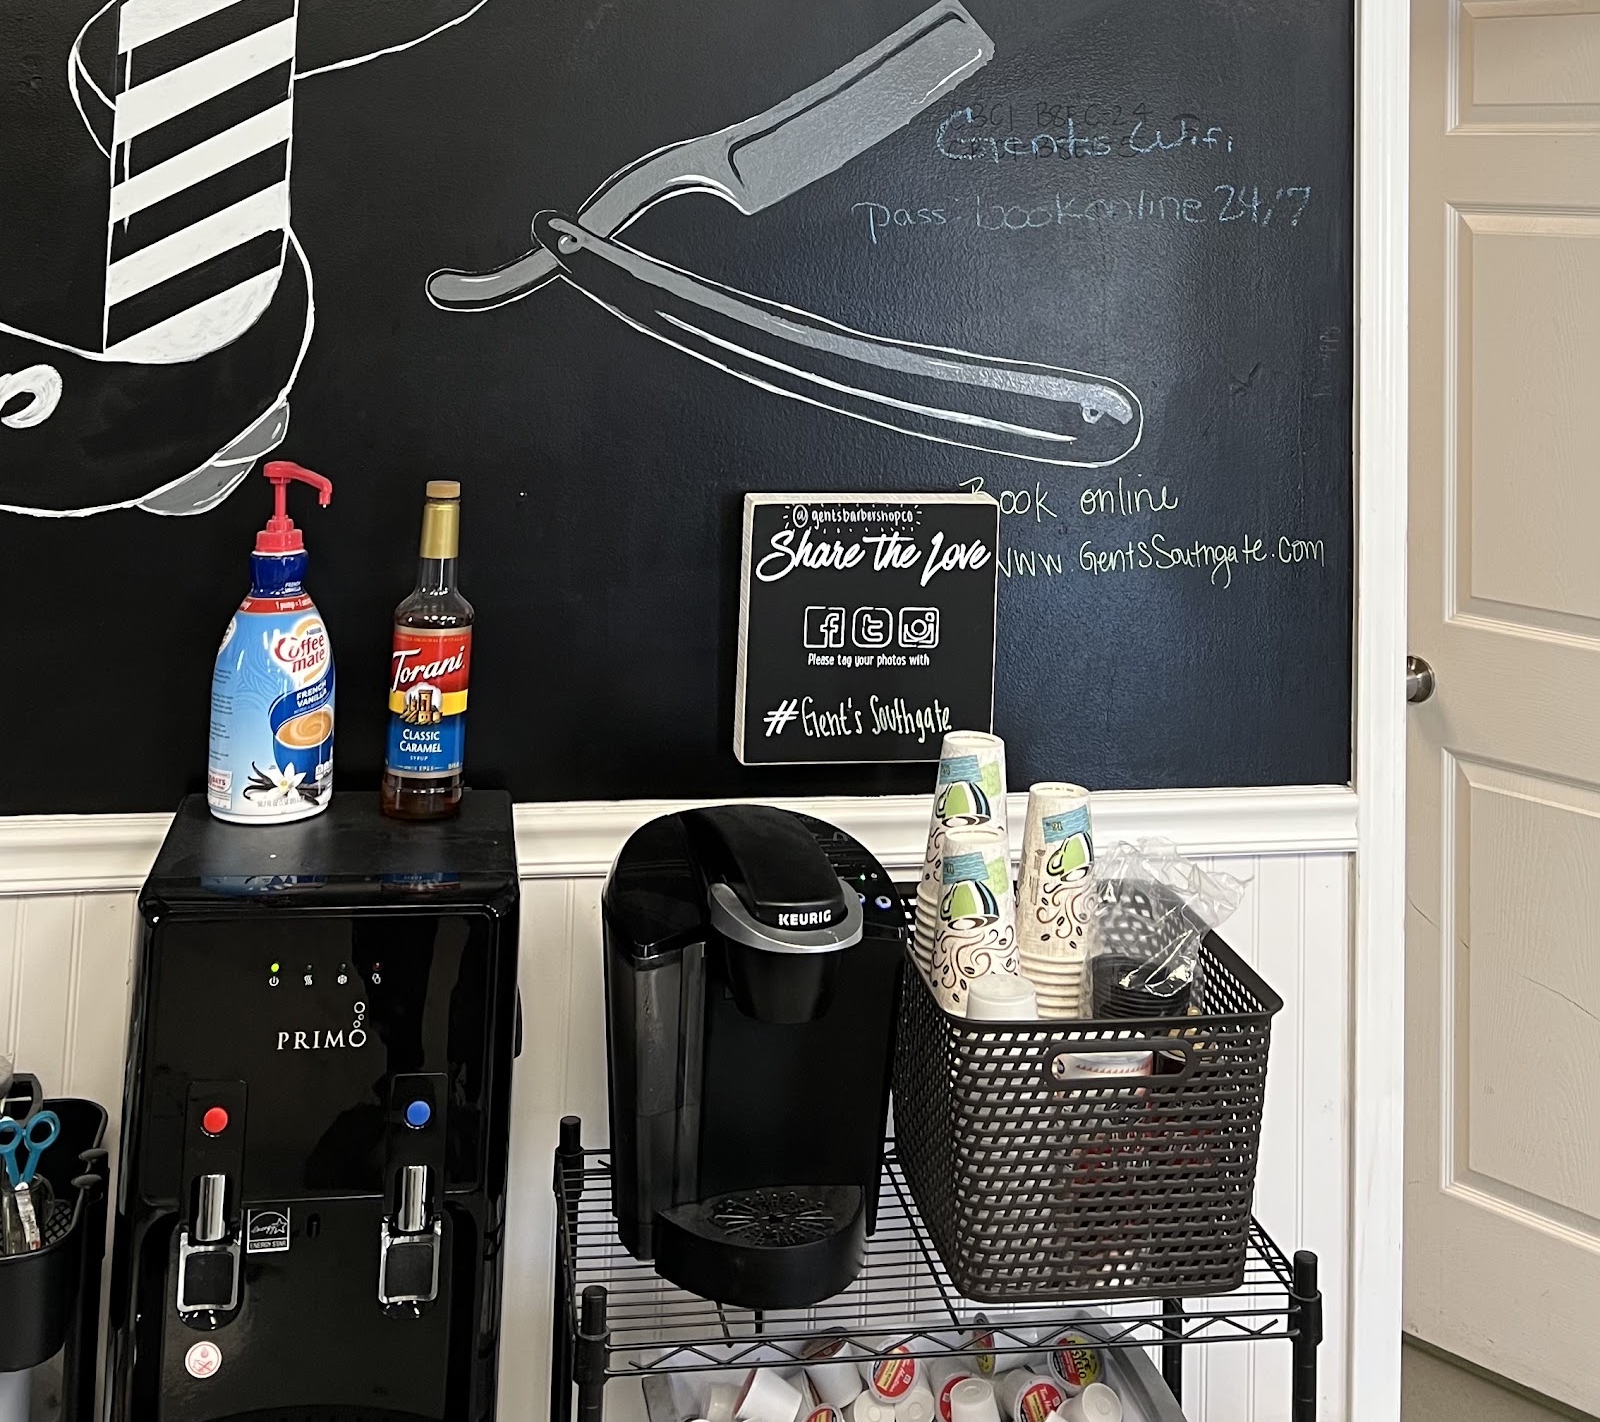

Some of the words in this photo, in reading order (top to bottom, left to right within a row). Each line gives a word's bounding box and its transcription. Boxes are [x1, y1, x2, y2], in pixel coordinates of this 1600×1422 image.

[1080, 473, 1179, 516] online
[755, 527, 866, 583] Share
[862, 531, 922, 572] the
[919, 531, 992, 588] Love
[274, 635, 325, 662] Coffee
[292, 649, 326, 673] mate
[393, 645, 466, 693] Torani
[808, 653, 835, 667] Please
[838, 654, 853, 668] tag
[854, 655, 875, 668] your
[876, 654, 907, 668] photos
[909, 653, 930, 667] with
[297, 679, 327, 700] FRENCH
[869, 694, 953, 744] Southgate
[402, 728, 441, 741] CLASSIC
[399, 740, 443, 753] CARAMEL
[778, 909, 832, 927] KEURIG
[276, 1028, 367, 1050] PRIMO
